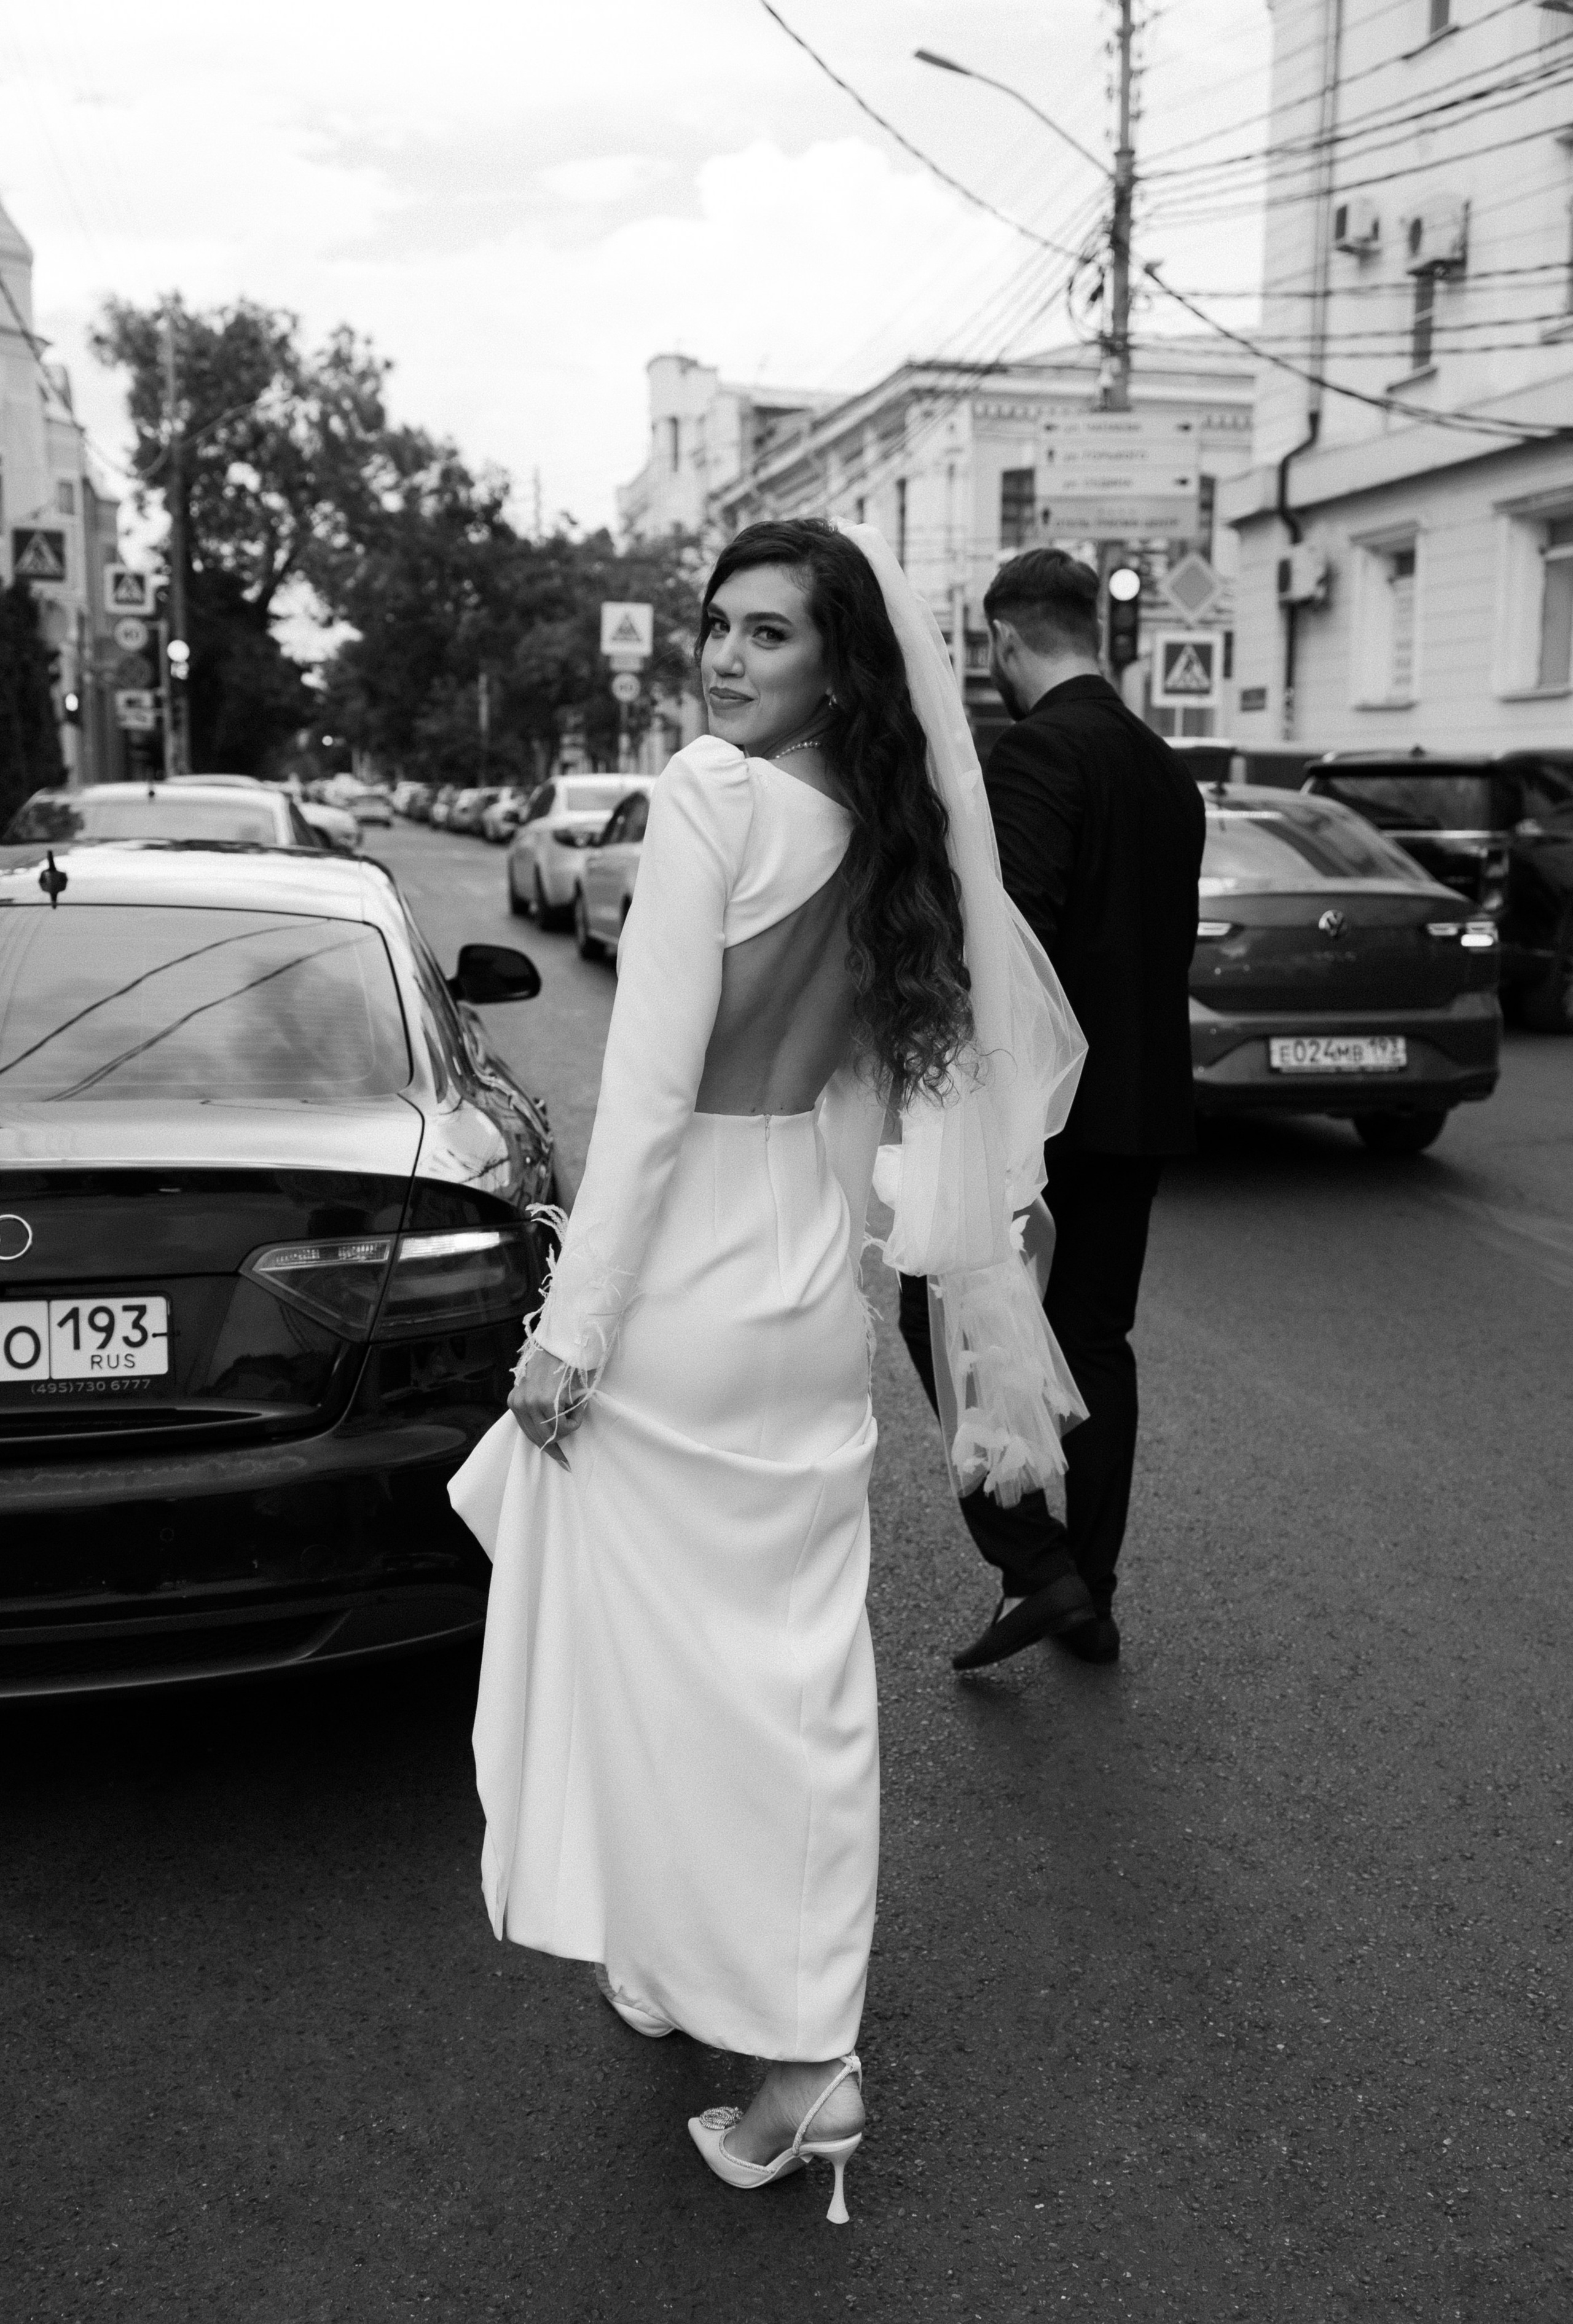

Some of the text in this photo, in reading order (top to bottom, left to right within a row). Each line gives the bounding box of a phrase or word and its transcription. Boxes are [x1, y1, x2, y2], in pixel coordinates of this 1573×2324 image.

[57, 1304, 149, 1350] 193
[90, 1353, 136, 1370] RUS
[110, 1378, 152, 1391] 6777
